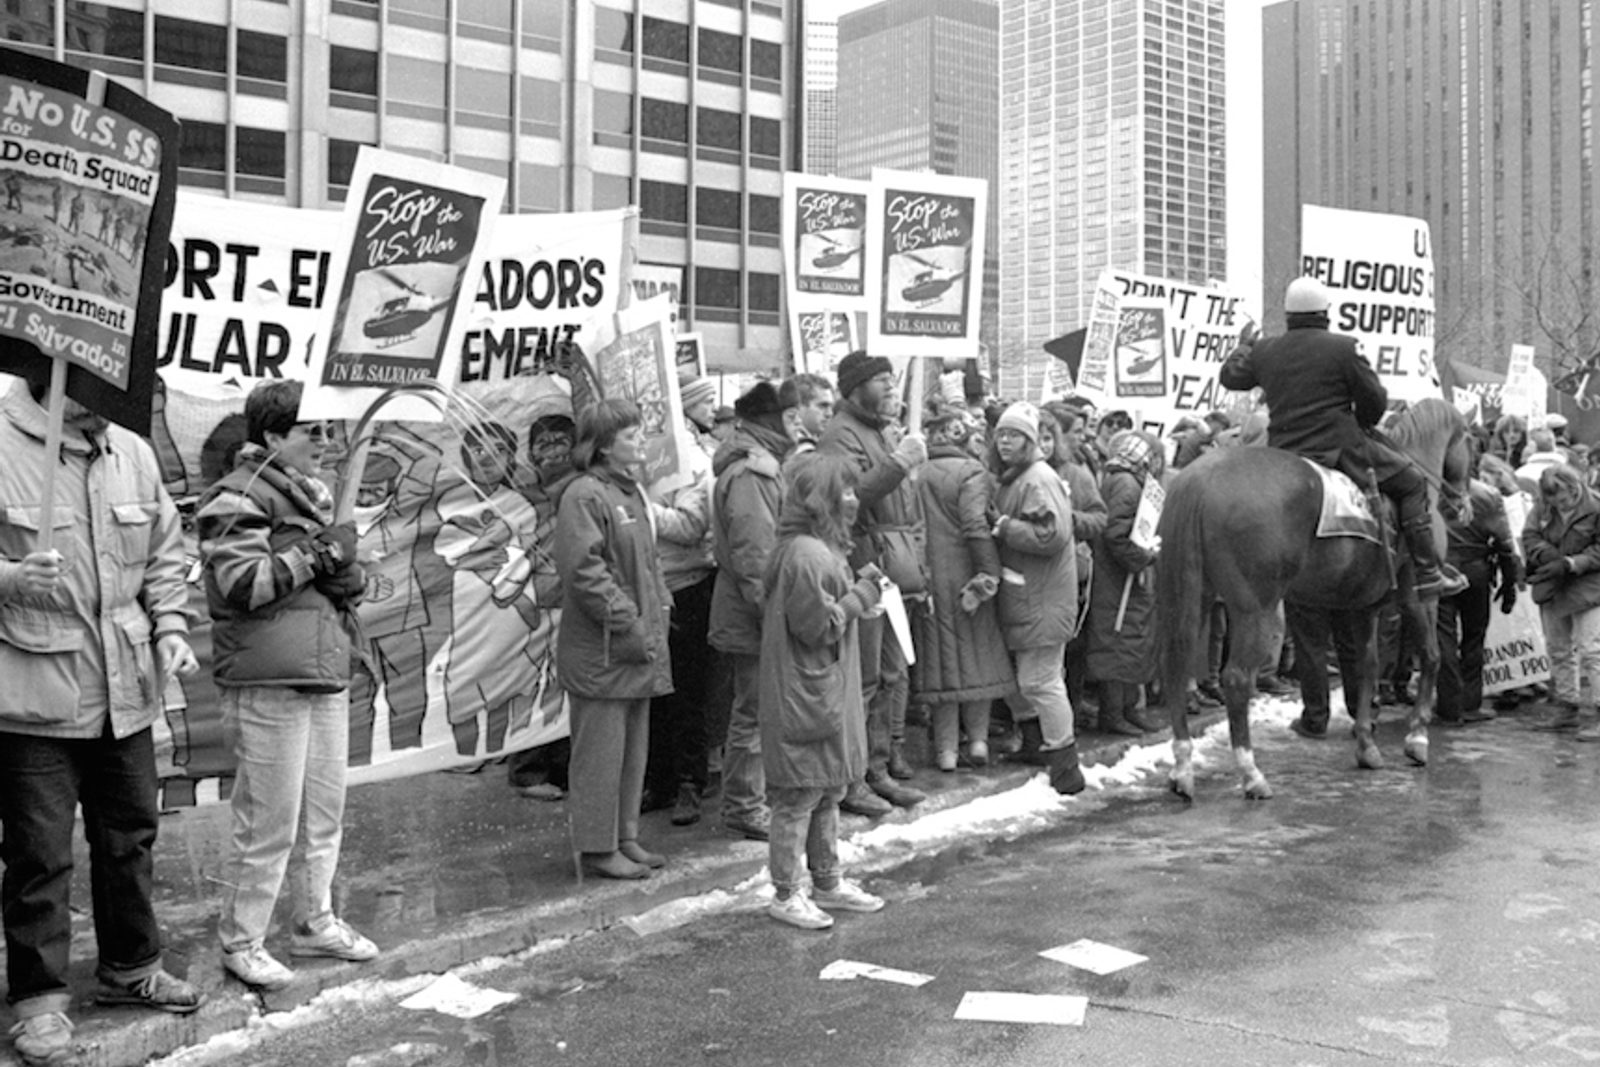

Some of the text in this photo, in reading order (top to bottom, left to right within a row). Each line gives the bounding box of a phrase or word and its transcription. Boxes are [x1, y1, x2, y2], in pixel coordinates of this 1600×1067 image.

[0, 116, 32, 137] for
[3, 84, 64, 127] No
[71, 103, 117, 150] U.S.
[0, 140, 153, 196] Death Squad
[366, 186, 463, 239] Stop the
[799, 192, 840, 219] Stop
[887, 196, 940, 233] Stop
[367, 229, 457, 266] U.S. War
[926, 222, 961, 244] War
[1303, 255, 1425, 296] RELIGIOUS
[0, 275, 127, 330] Government
[1206, 293, 1240, 327] THE
[912, 320, 961, 334] SALVADOR
[24, 313, 124, 378] Salvador
[111, 338, 126, 357] in
[1376, 346, 1408, 377] EL
[330, 363, 433, 384] IN EL SALVADOR
